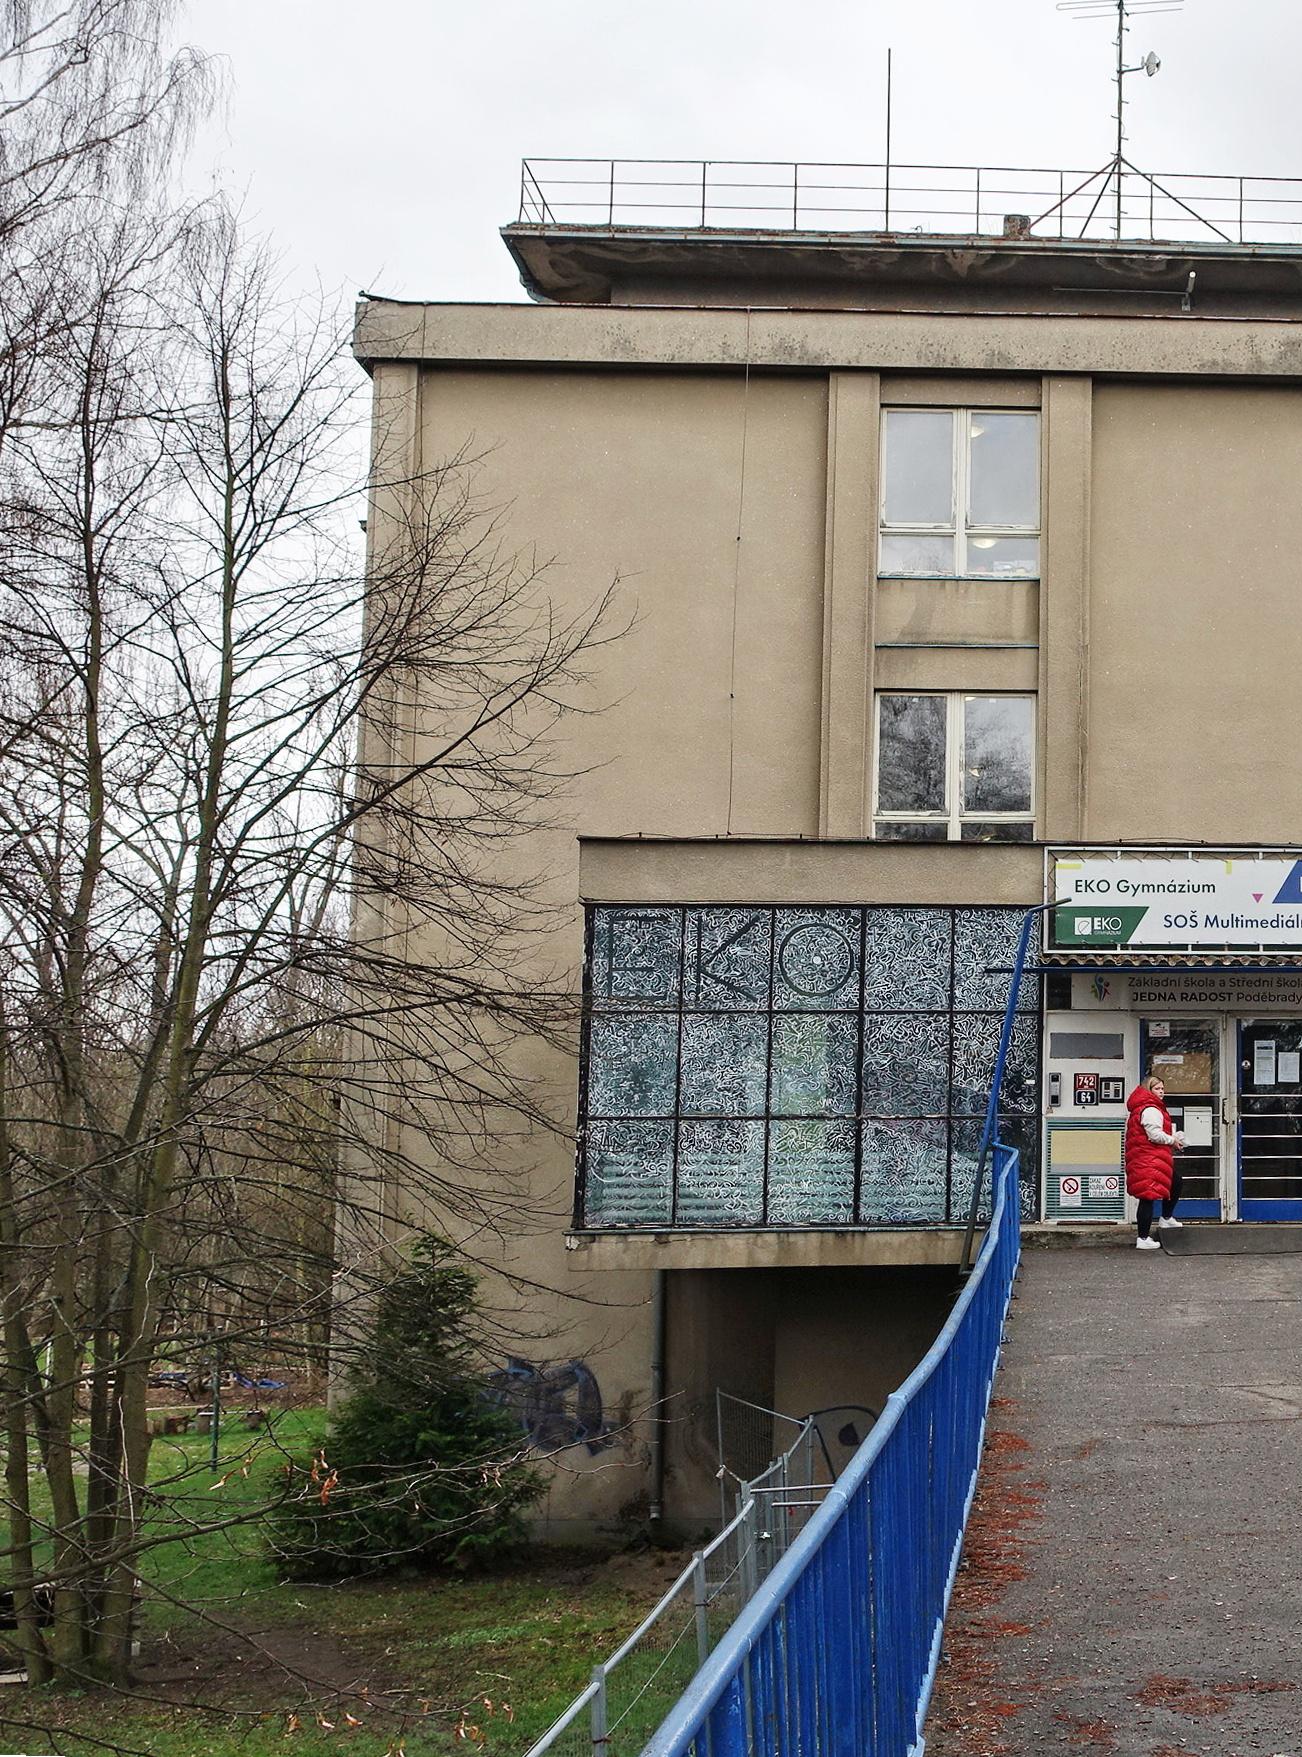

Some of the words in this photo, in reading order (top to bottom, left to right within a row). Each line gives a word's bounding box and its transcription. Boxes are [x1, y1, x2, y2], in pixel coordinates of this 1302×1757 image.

[1075, 879, 1111, 893] EKO
[1116, 879, 1216, 897] Gymnázium
[1093, 917, 1122, 930] EKO
[1163, 910, 1198, 928] SOŠ
[1128, 977, 1181, 987] Základní
[1183, 977, 1216, 988] škola
[1219, 979, 1226, 988] a
[1229, 977, 1274, 988] Střední
[1132, 992, 1177, 1002] JEDNA
[1180, 992, 1233, 1002] RADOST
[1237, 992, 1302, 1004] Poděbrady
[1078, 1076, 1095, 1086] 742
[1081, 1092, 1091, 1102] 64
